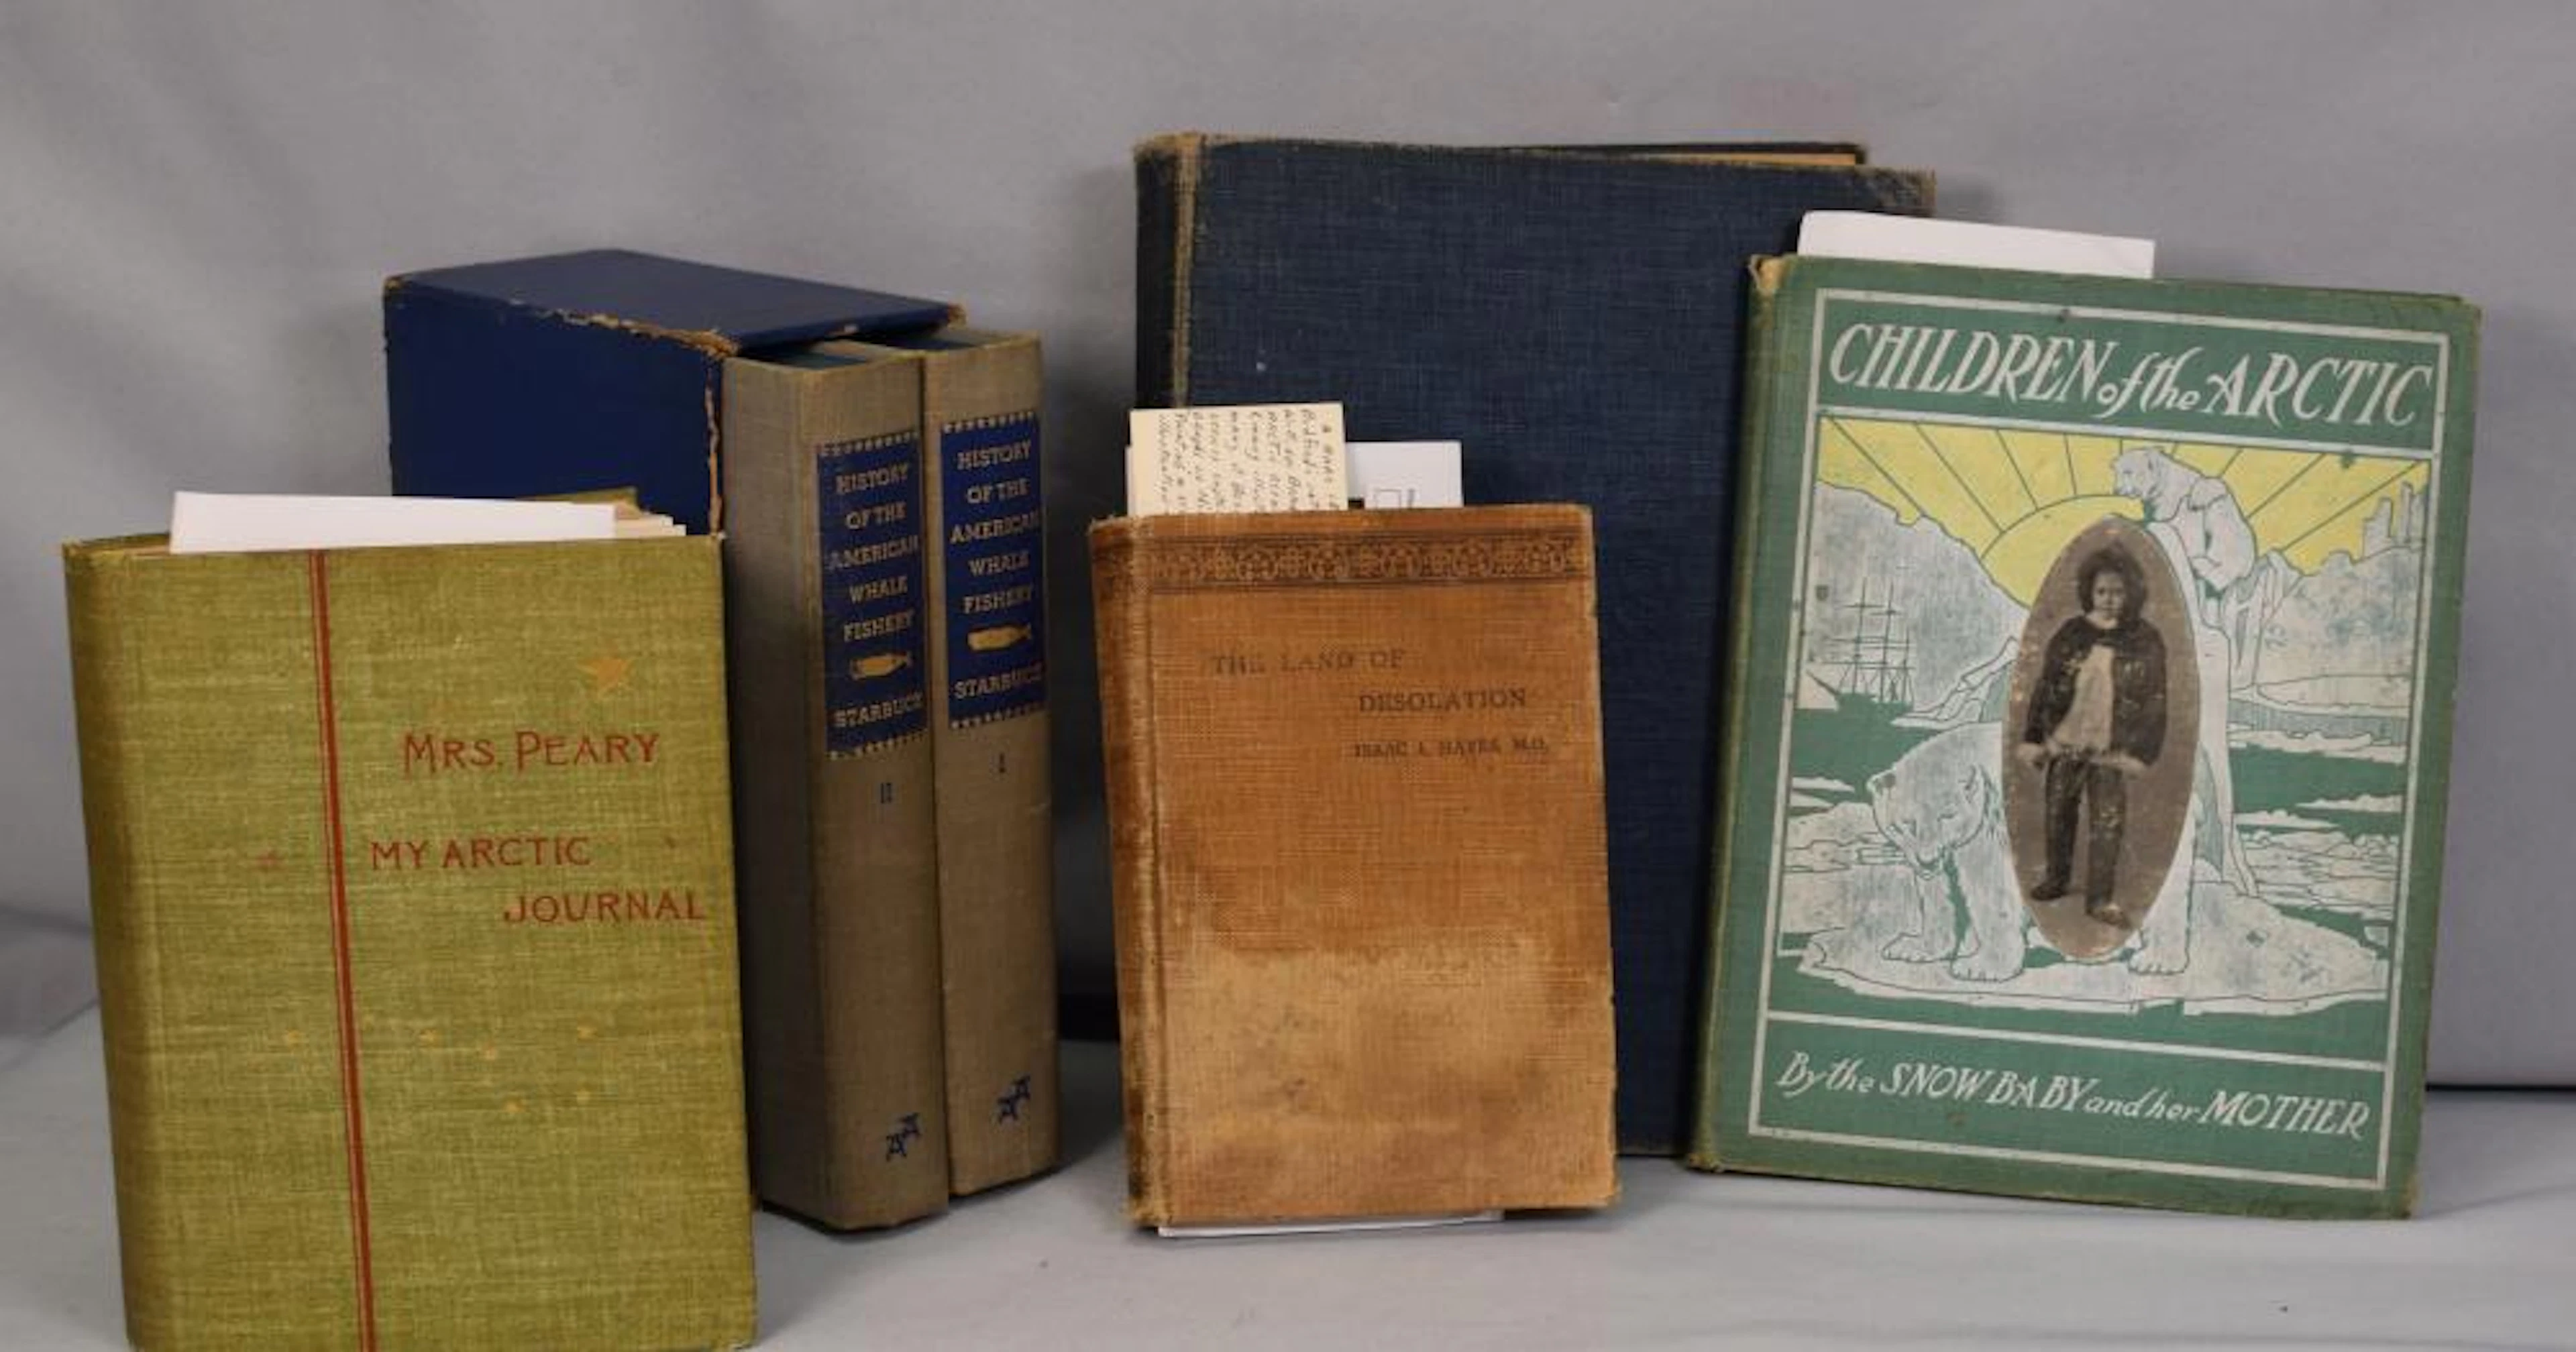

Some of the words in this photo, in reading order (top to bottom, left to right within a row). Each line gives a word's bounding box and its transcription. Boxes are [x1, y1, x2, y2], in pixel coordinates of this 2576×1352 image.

[1828, 322, 2118, 404] CHILDREN
[2097, 349, 2148, 419] of
[2141, 347, 2203, 410] the
[2204, 351, 2432, 428] ARCTIC
[957, 441, 1032, 470] HISTORY
[837, 463, 908, 494] HISTORY
[967, 484, 993, 504] OF
[998, 478, 1029, 498] THE
[845, 510, 869, 530] OF
[875, 501, 906, 522] THE
[951, 510, 1040, 543] AMERICAN
[828, 535, 918, 570] AMERICAN
[969, 549, 1029, 576] WHALE
[849, 576, 908, 604] WHALE
[964, 585, 1032, 613] FISHERY
[843, 610, 914, 642] FISHERY
[1212, 655, 1265, 675] THE
[1280, 651, 1354, 672] LAND
[1369, 649, 1405, 669] OF
[955, 663, 1041, 699] STARBUCK
[834, 692, 923, 728] STARBUCK
[1359, 688, 1525, 713] DESOLATION
[370, 840, 429, 870] MY
[443, 836, 590, 869] ARCTIC
[504, 891, 706, 923] JOURNAL
[1776, 1052, 1829, 1098] By
[1824, 1053, 1874, 1094] the
[1880, 1062, 1996, 1103] SNOW
[1987, 1072, 2100, 1112] BABY
[2085, 1086, 2151, 1119] and
[2145, 1086, 2200, 1123] her
[2199, 1090, 2371, 1141] MOTHER
